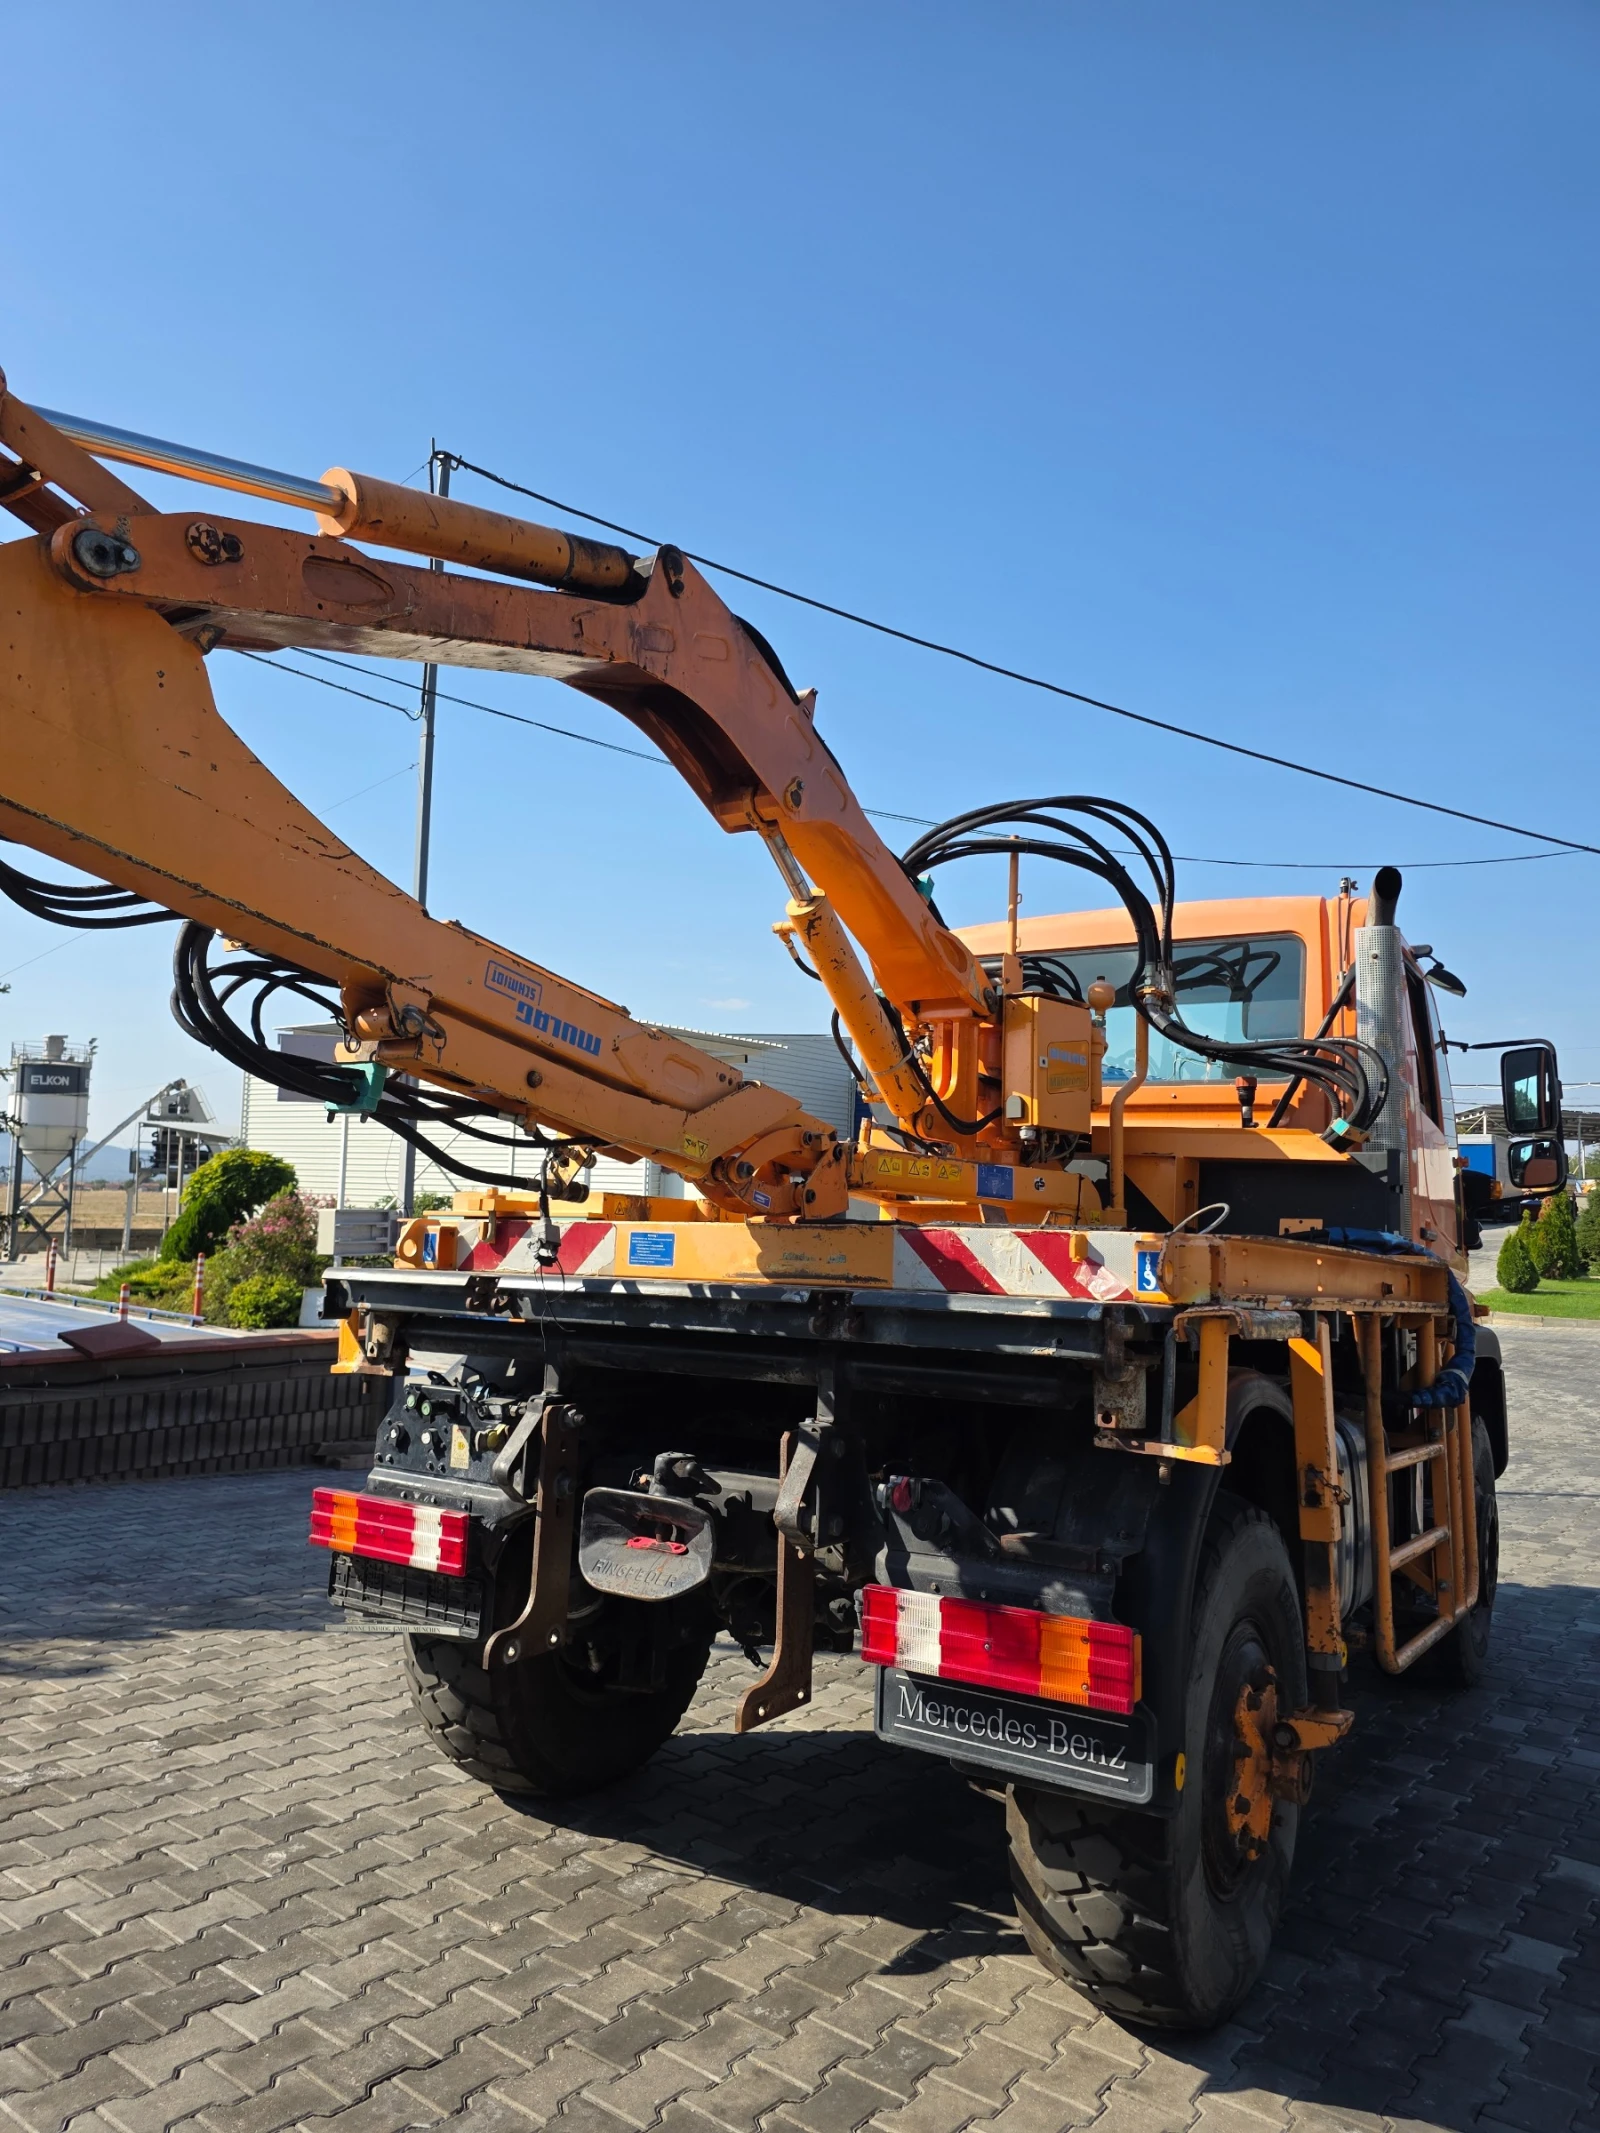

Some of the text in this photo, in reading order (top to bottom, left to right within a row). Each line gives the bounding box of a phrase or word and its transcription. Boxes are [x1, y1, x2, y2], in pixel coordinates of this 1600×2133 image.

[491, 969, 536, 1000] SCHMIDT
[516, 1000, 601, 1056] MULAG
[30, 1074, 70, 1086] ELKON
[591, 1559, 677, 1588] RINGFEDER
[896, 1684, 1127, 1771] Mercedes-Benz
